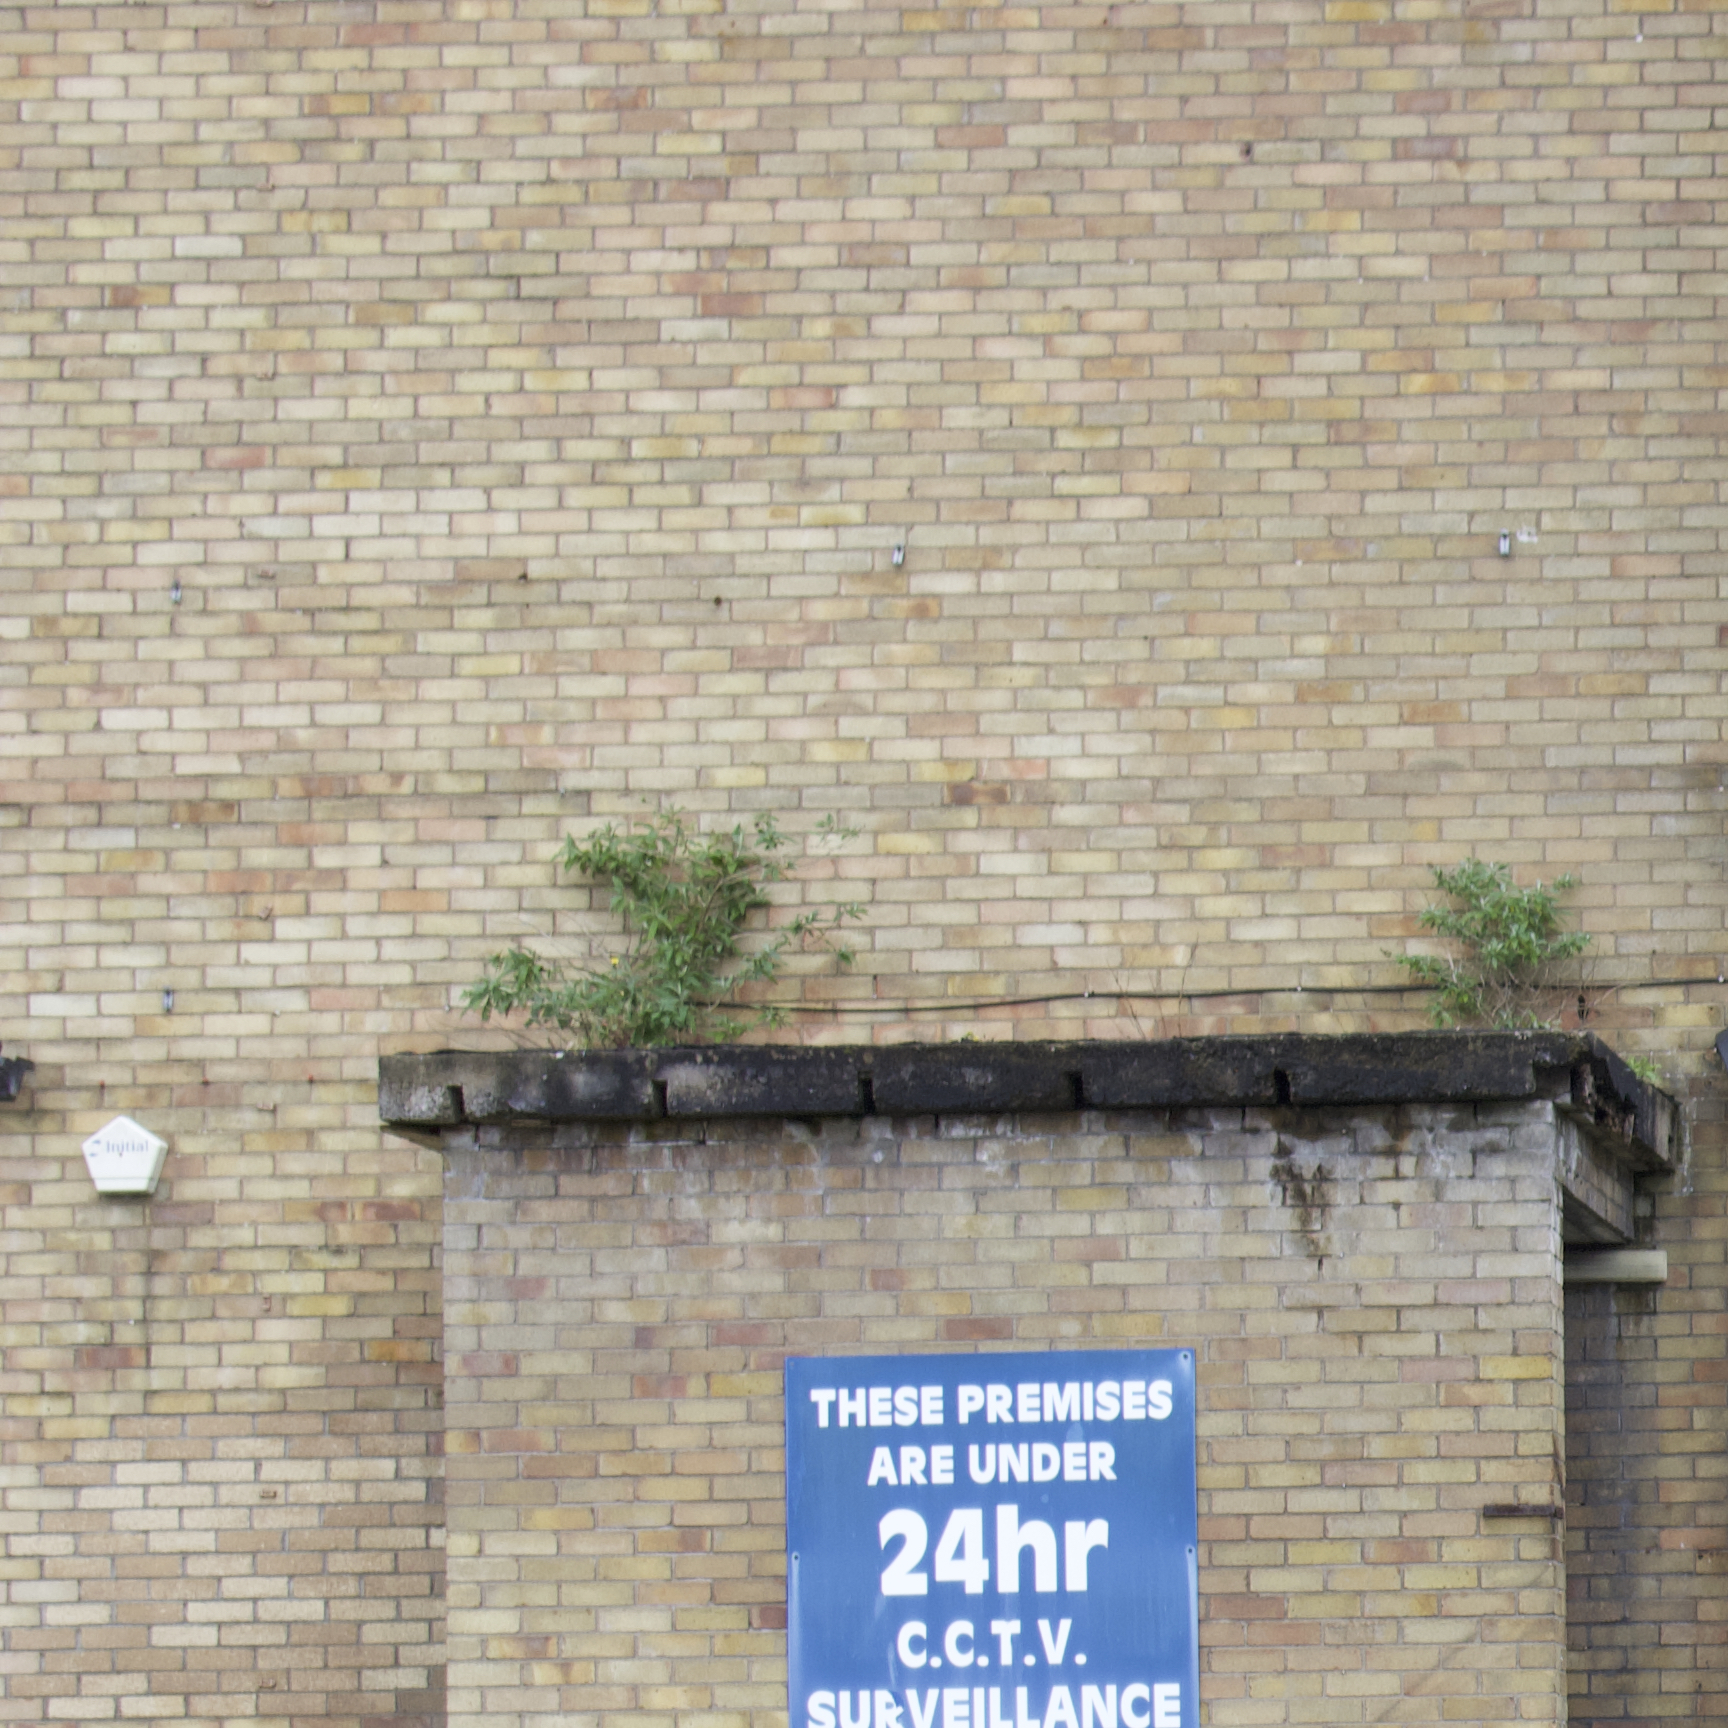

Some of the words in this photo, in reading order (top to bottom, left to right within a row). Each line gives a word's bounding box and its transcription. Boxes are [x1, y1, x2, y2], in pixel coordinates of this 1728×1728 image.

[106, 1139, 149, 1153] Initial
[810, 1385, 944, 1428] THESE
[957, 1380, 1173, 1424] PREMISES
[867, 1444, 954, 1486] ARE
[968, 1441, 1117, 1484] UNDER
[879, 1503, 1109, 1596] 24hr
[897, 1618, 1087, 1669] C.C.T.V.
